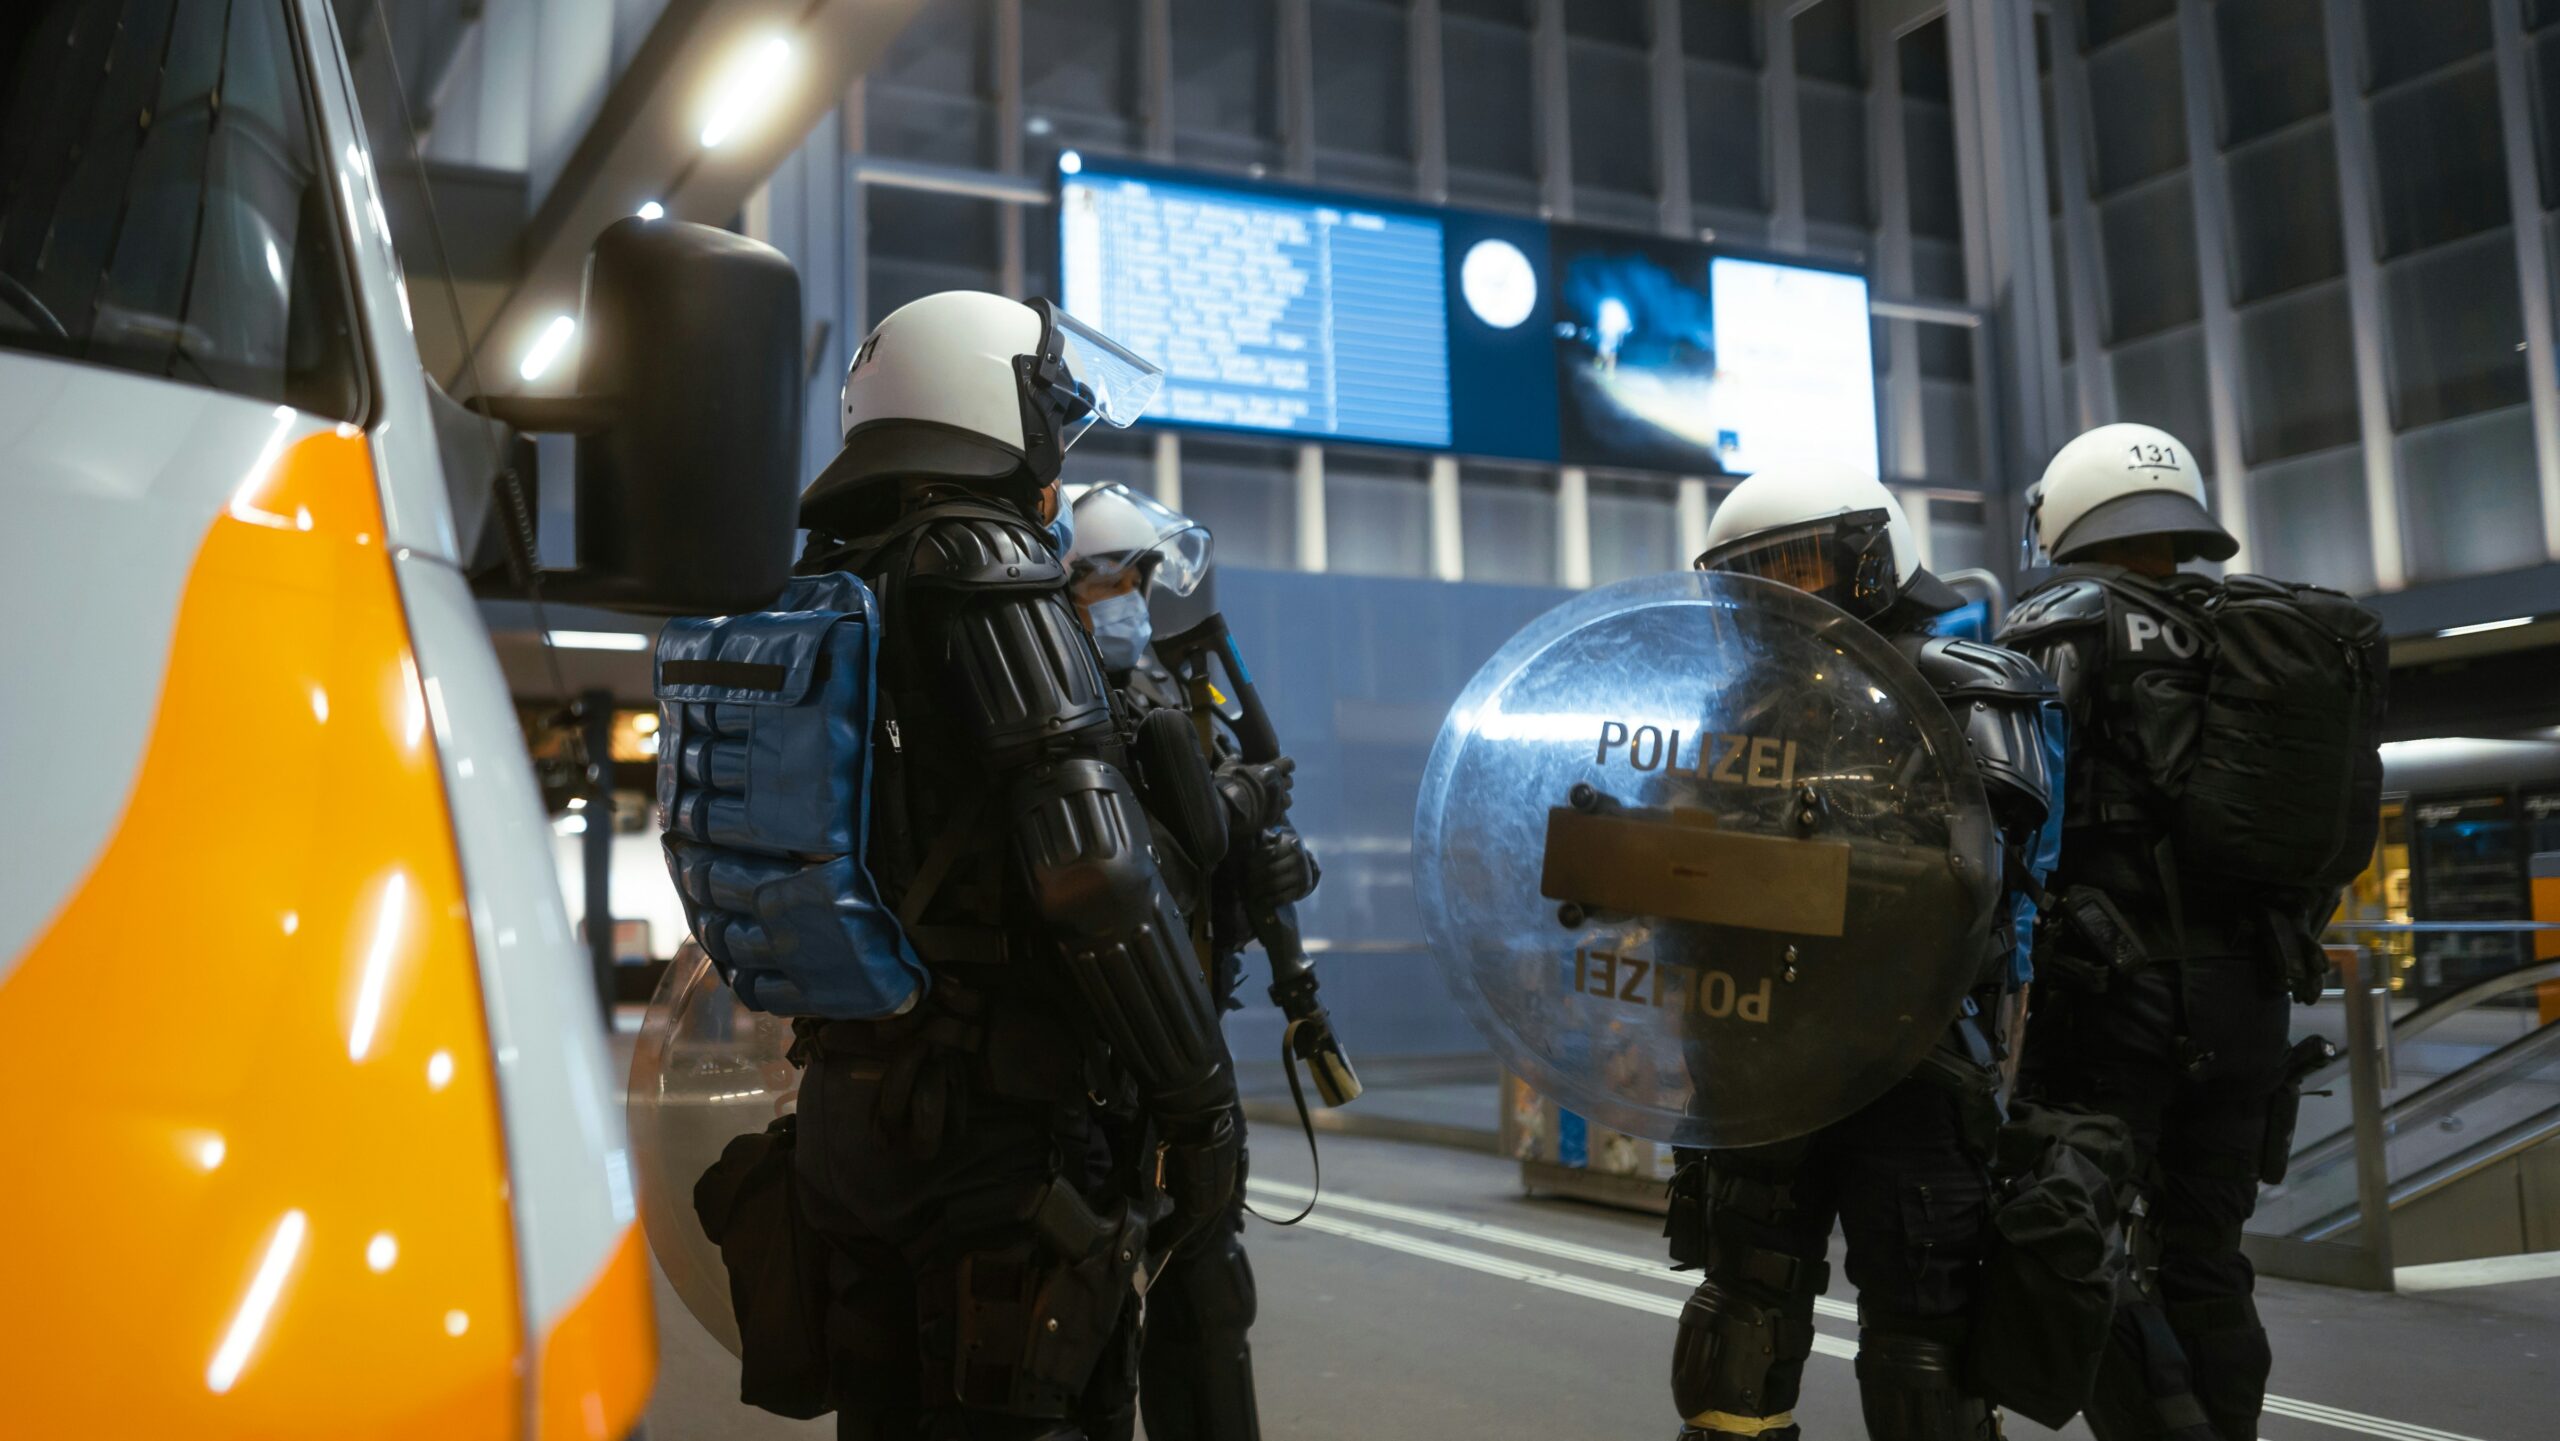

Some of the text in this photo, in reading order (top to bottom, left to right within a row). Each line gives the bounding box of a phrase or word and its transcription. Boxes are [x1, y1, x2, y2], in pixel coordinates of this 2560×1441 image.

[2129, 444, 2177, 465] 131
[1595, 720, 1798, 790] POLIZEI
[1574, 947, 1773, 1025] POLIZEI
